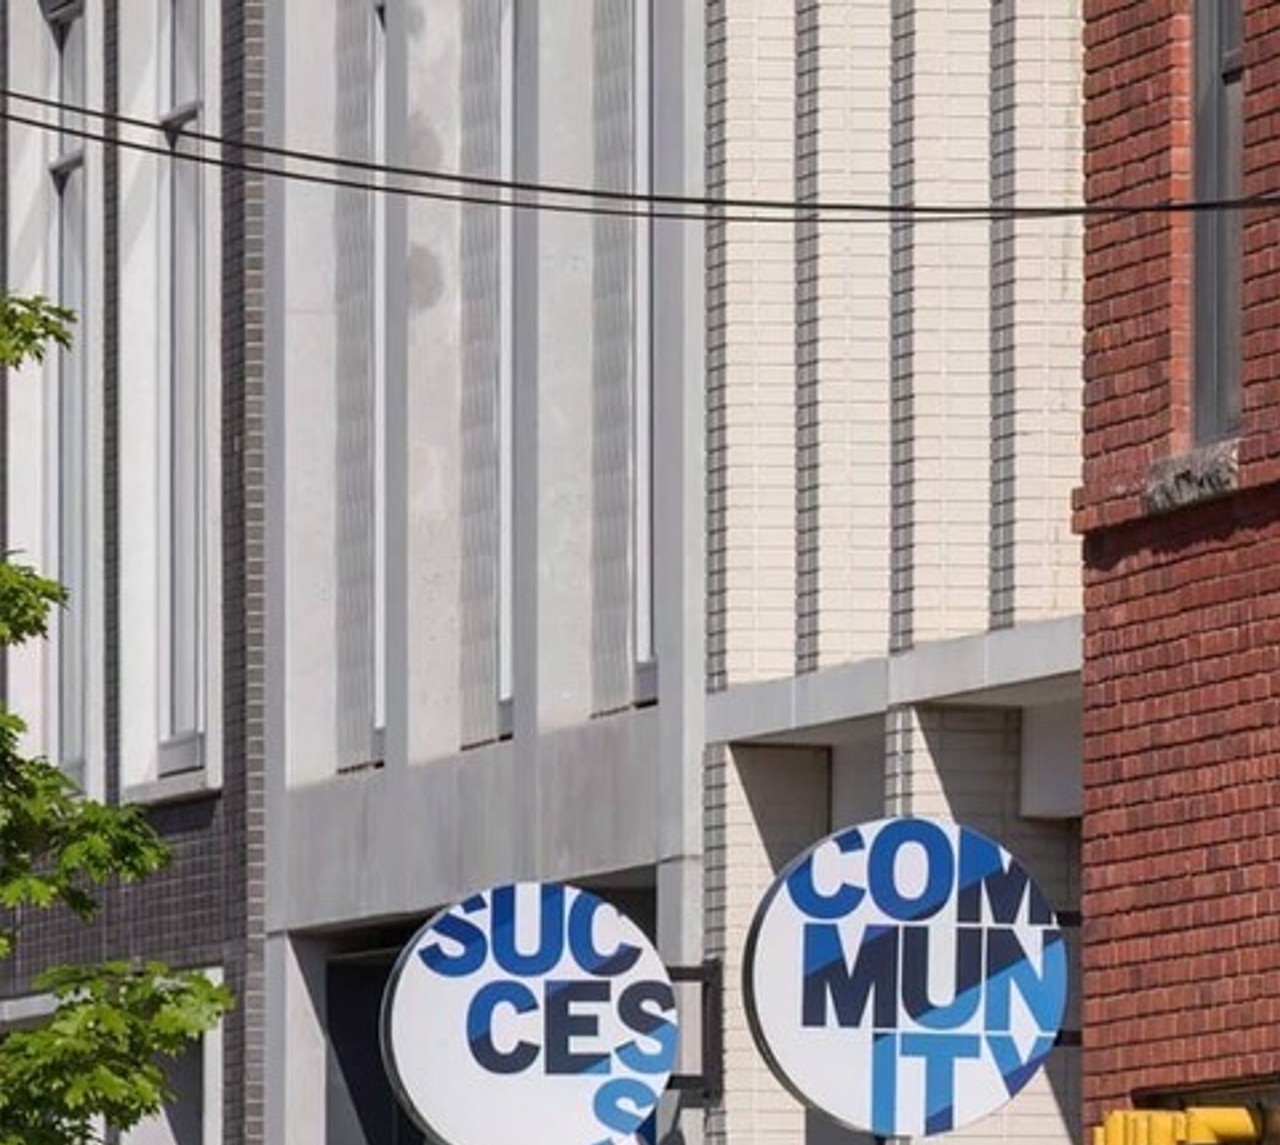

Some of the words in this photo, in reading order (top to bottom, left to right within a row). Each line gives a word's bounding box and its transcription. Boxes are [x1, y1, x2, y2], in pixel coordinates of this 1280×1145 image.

[785, 818, 1055, 924] COM
[417, 881, 642, 978] SUC
[801, 924, 1068, 1031] MUN
[466, 979, 678, 1075] CES
